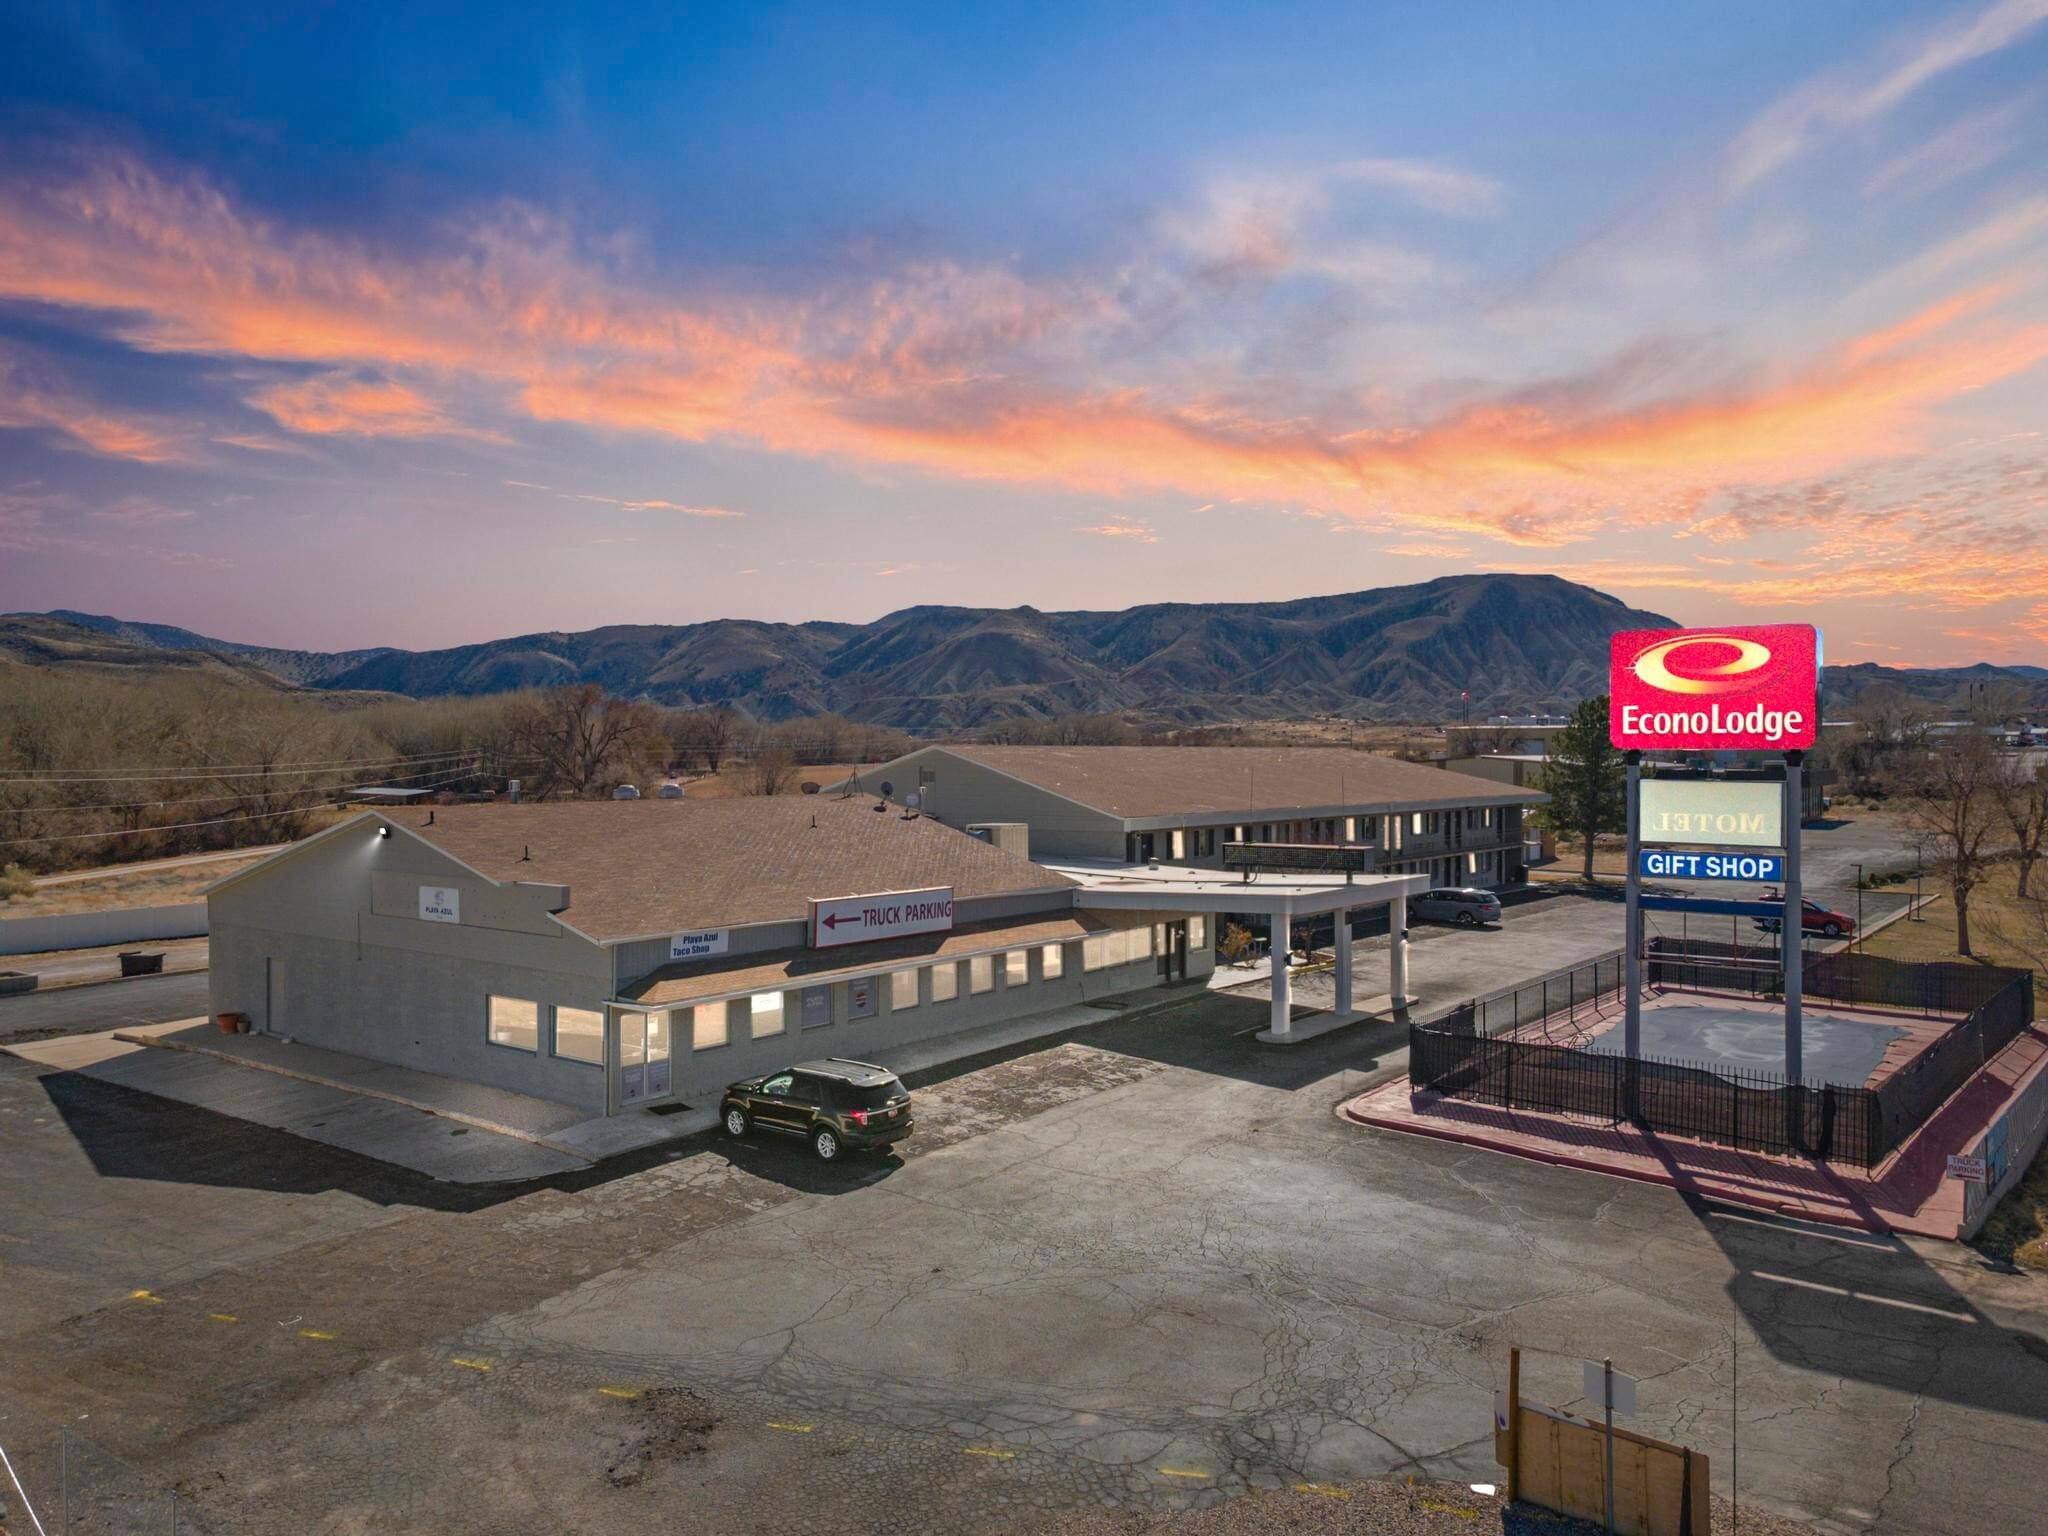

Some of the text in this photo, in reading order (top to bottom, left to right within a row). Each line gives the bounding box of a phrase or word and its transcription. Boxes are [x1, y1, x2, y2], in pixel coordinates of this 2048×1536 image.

[1622, 704, 1803, 741] EconoLodge
[1647, 854, 1774, 879] GIFT SHOP
[862, 901, 952, 927] TRUCK PARKING
[683, 932, 719, 945] Playa Azul
[673, 944, 710, 957] Taco Shop
[1949, 1156, 1985, 1175] TRUCK PARKING
